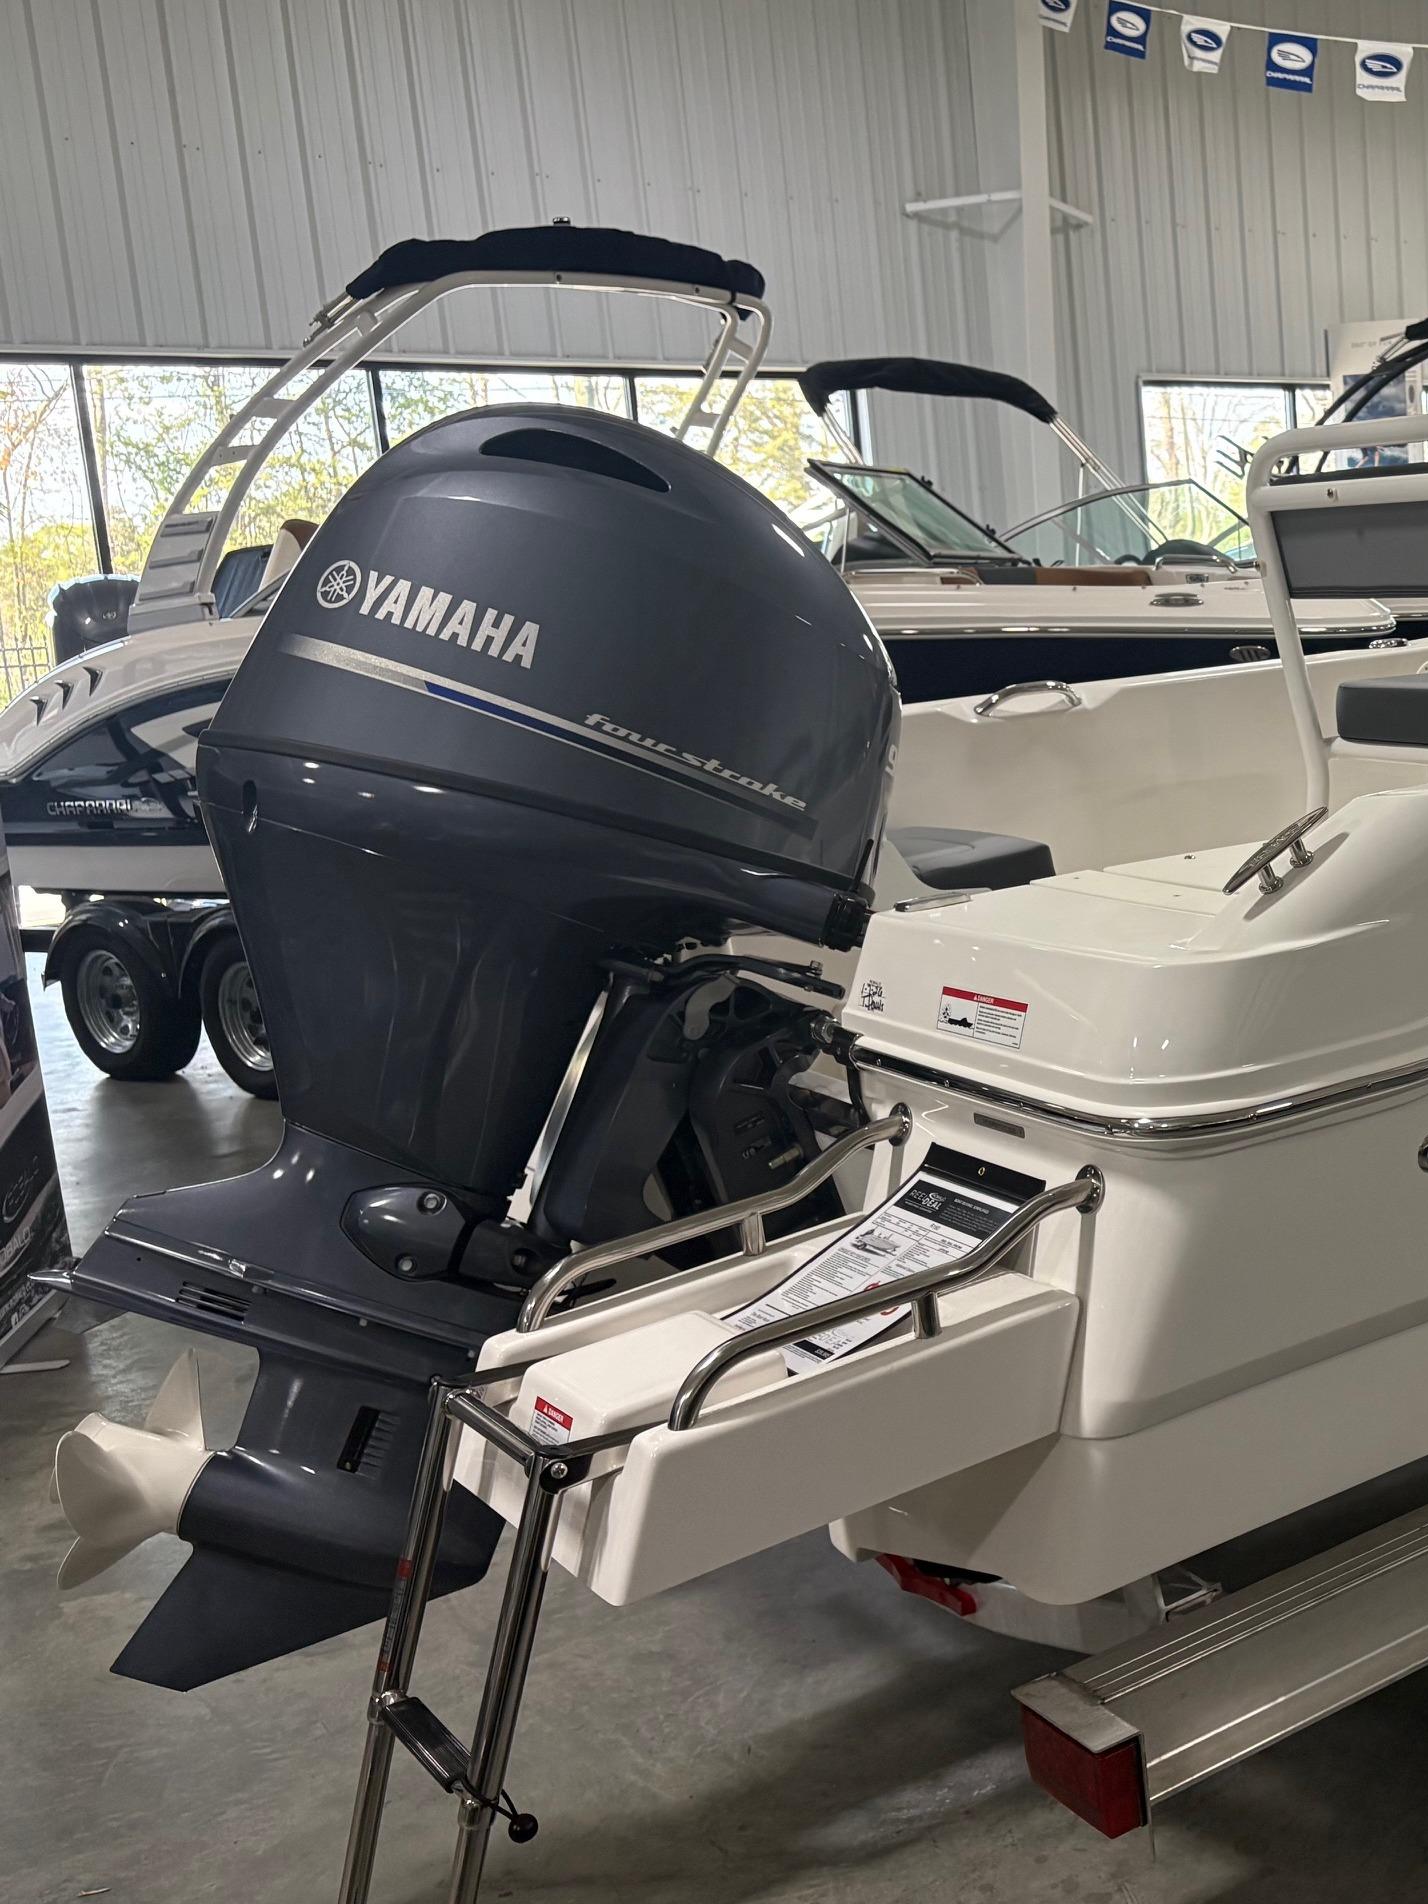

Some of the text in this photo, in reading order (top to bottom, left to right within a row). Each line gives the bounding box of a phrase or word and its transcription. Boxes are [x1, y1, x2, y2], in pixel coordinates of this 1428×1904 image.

[359, 570, 541, 669] YAMAHA
[922, 1197, 942, 1210] DEAL
[548, 1407, 564, 1423] DANGER
